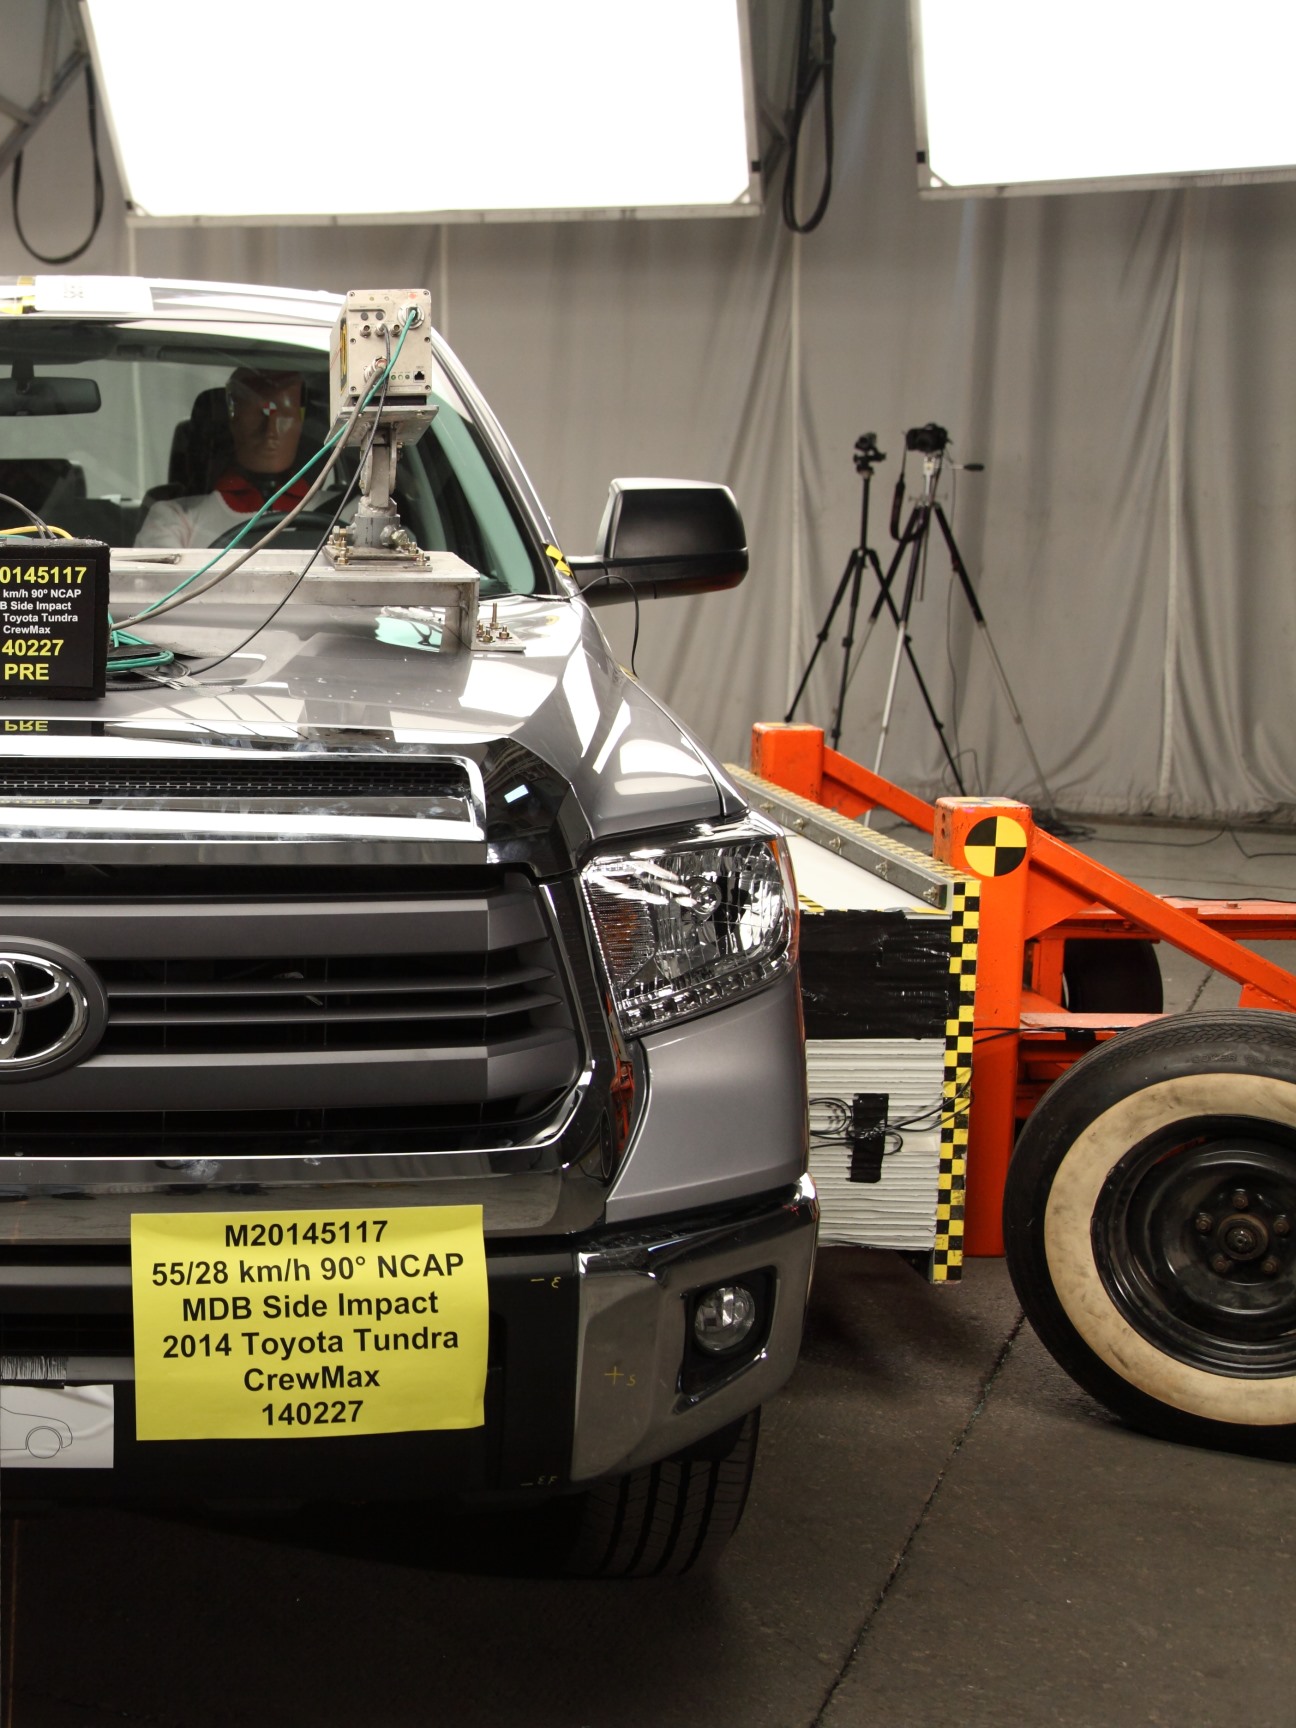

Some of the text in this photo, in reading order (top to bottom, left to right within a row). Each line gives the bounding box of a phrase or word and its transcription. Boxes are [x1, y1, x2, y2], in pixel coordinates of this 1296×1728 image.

[3, 588, 29, 598] km/h
[50, 588, 82, 598] NCAP
[2, 613, 39, 625] Toyota
[41, 613, 79, 622] Tundra
[10, 601, 34, 611] Side
[36, 601, 72, 613] Impact
[2, 625, 51, 634] CrewMax
[4, 664, 50, 680] PRE
[225, 1220, 388, 1247] M20145117
[152, 1252, 464, 1286] 55/28 km/h 90° NCAP
[182, 1290, 439, 1321] MDB Side Impact
[163, 1327, 459, 1361] 2014 Toyota Tundra
[243, 1365, 381, 1392] CrewMax
[261, 1400, 364, 1426] 140227
